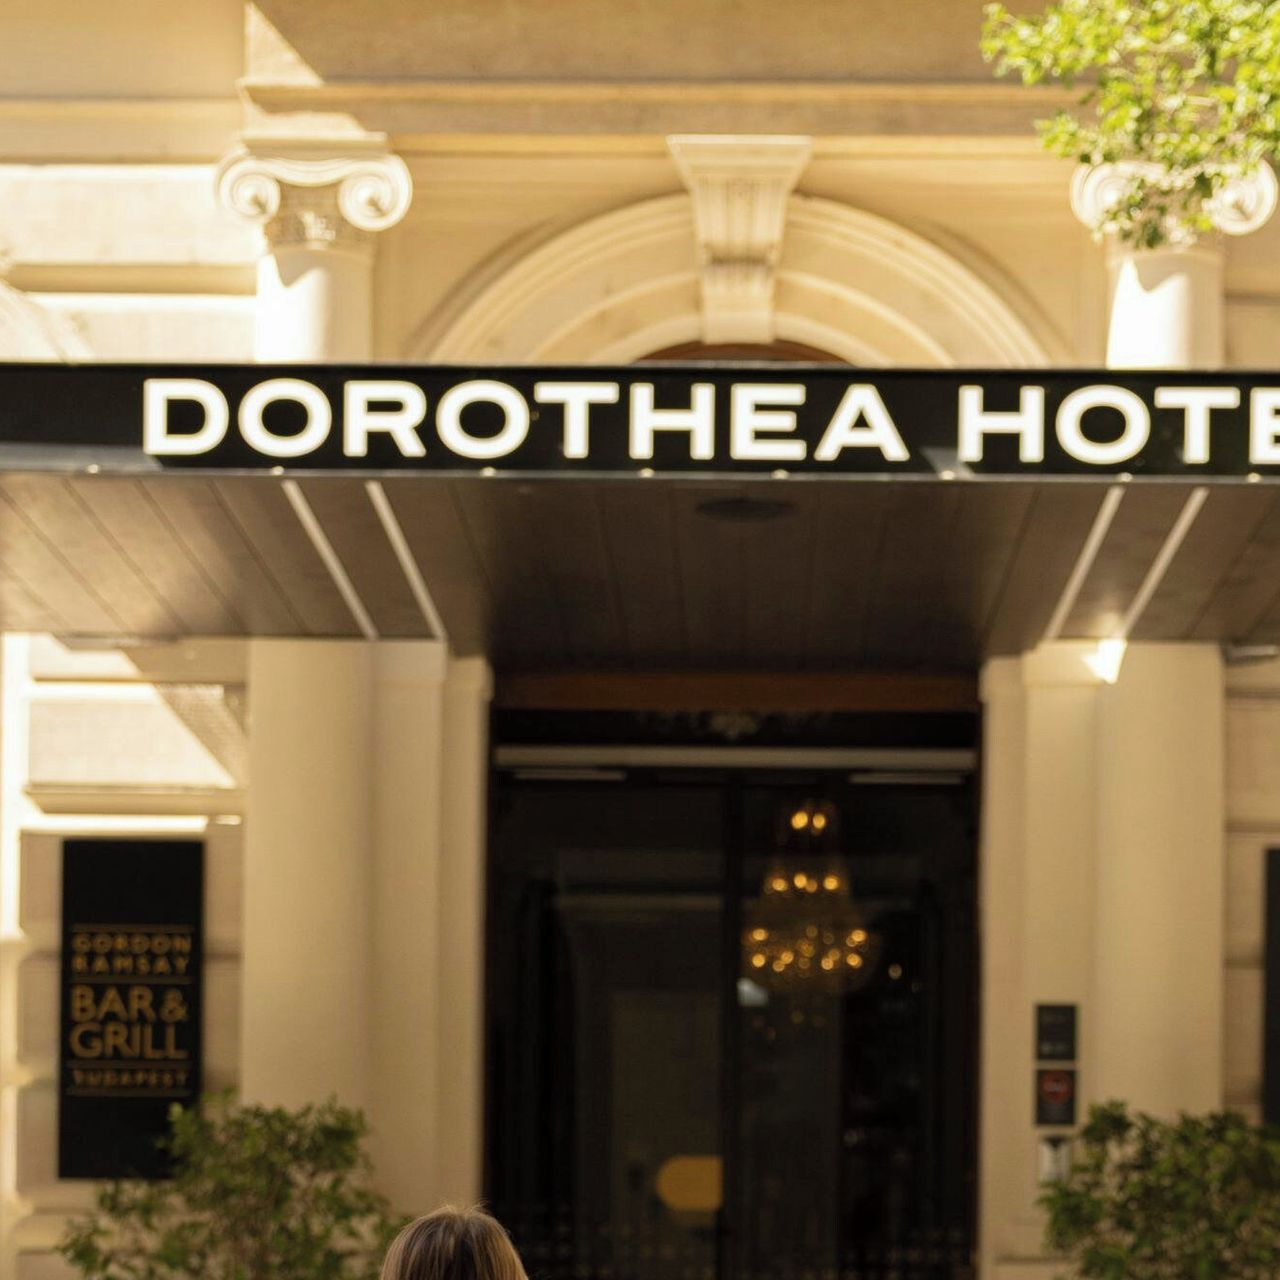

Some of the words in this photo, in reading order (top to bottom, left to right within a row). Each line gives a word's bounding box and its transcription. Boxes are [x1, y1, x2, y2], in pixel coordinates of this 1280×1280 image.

[142, 377, 911, 462] DOROTHEA
[70, 985, 156, 1022] BAR
[160, 987, 190, 1023] &
[70, 1021, 189, 1060] GRILL
